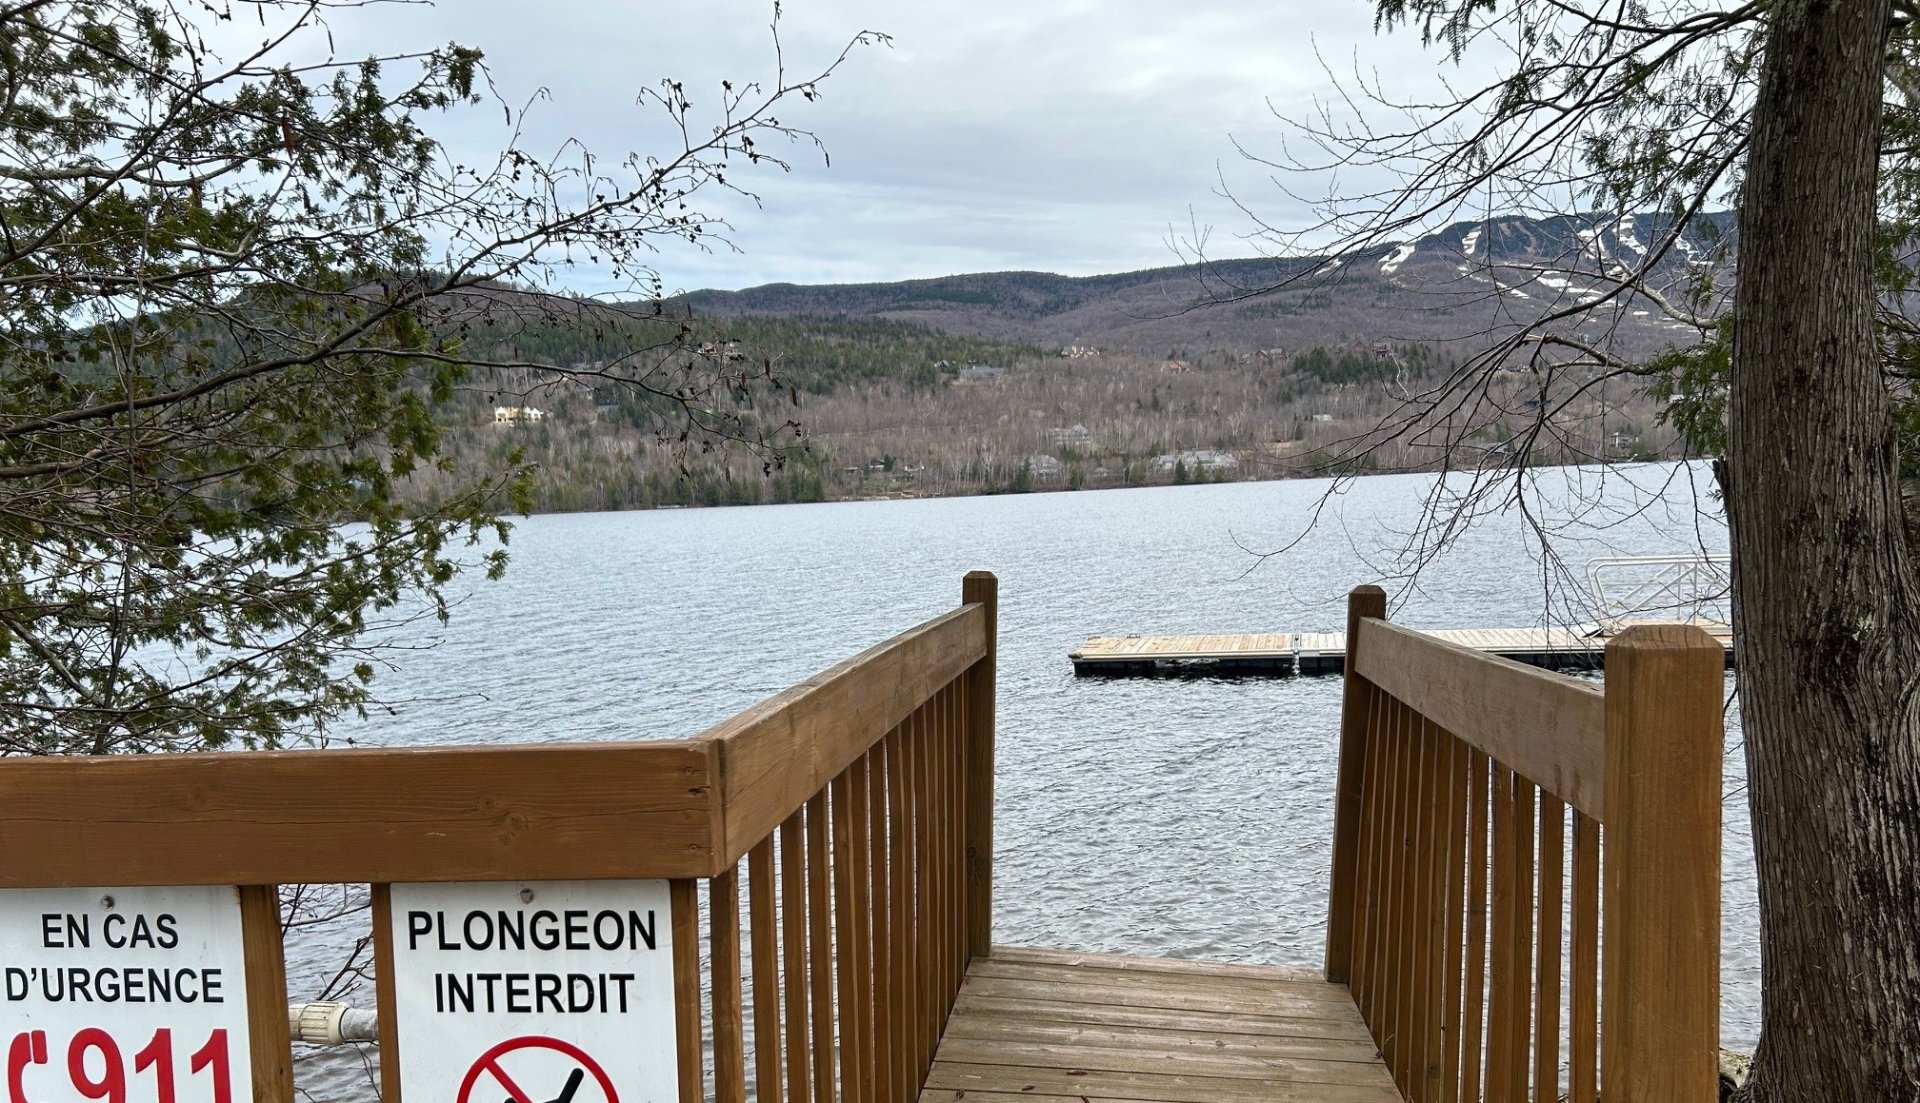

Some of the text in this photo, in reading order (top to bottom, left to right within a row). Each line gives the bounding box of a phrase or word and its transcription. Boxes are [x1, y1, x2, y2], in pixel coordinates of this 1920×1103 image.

[42, 914, 179, 949] EN CAS
[408, 910, 657, 950] PLONGEON
[5, 967, 224, 1003] D'URGENCE
[435, 973, 635, 1013] INTERDIT
[67, 1027, 232, 1103] 911
